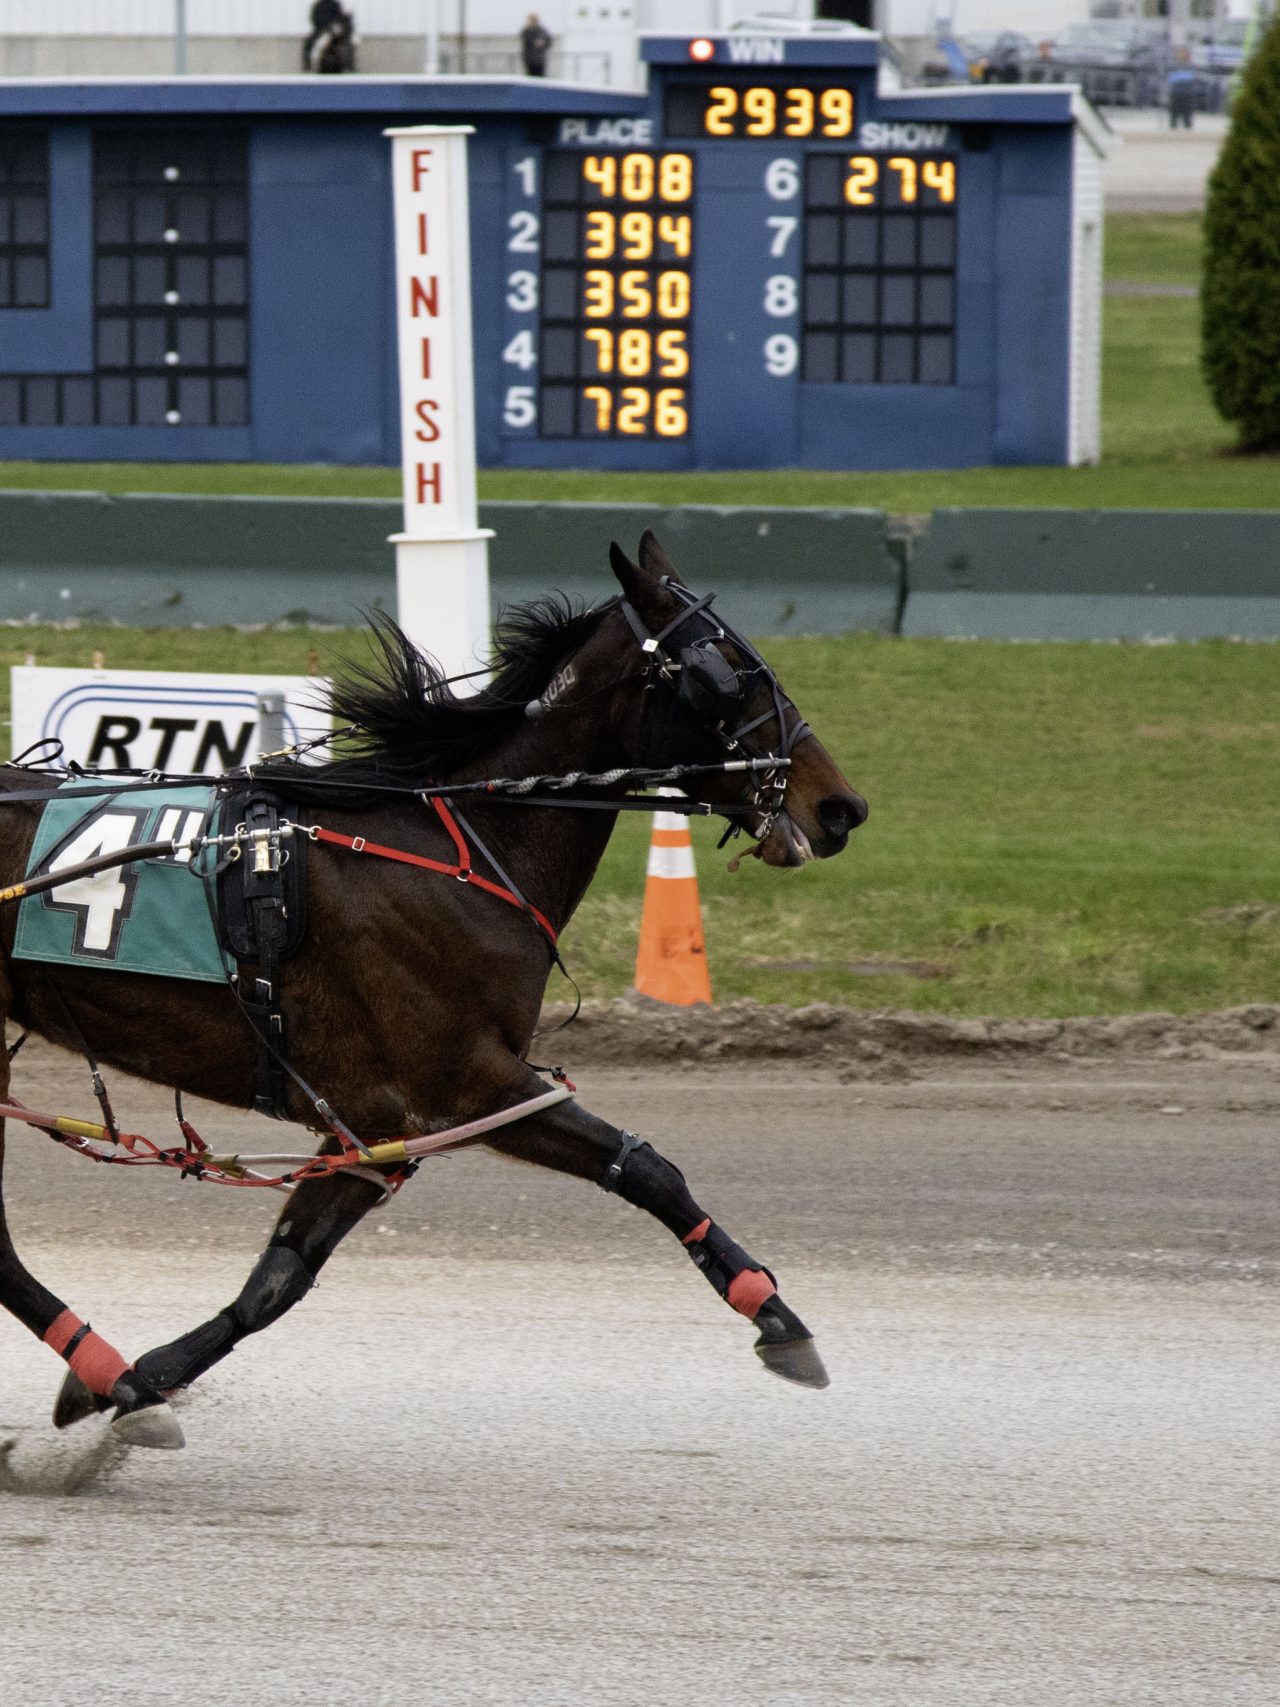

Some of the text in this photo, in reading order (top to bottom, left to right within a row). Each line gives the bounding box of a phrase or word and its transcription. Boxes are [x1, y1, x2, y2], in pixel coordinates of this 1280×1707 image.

[727, 38, 785, 63] WIN
[560, 119, 655, 146] PLACE
[705, 87, 854, 139] 2939
[858, 122, 949, 149] SHOW
[517, 154, 694, 204] 1 408
[766, 157, 957, 207] 6 274
[509, 211, 693, 262] 2 394
[768, 217, 798, 258] 7
[508, 270, 692, 321] 3 350
[765, 276, 798, 318] 8
[410, 149, 443, 505] FINISH
[504, 328, 691, 380] 4 785
[765, 335, 799, 377] 9
[505, 387, 689, 438] 5 726
[86, 714, 256, 774] RTN
[48, 813, 138, 950] 4
